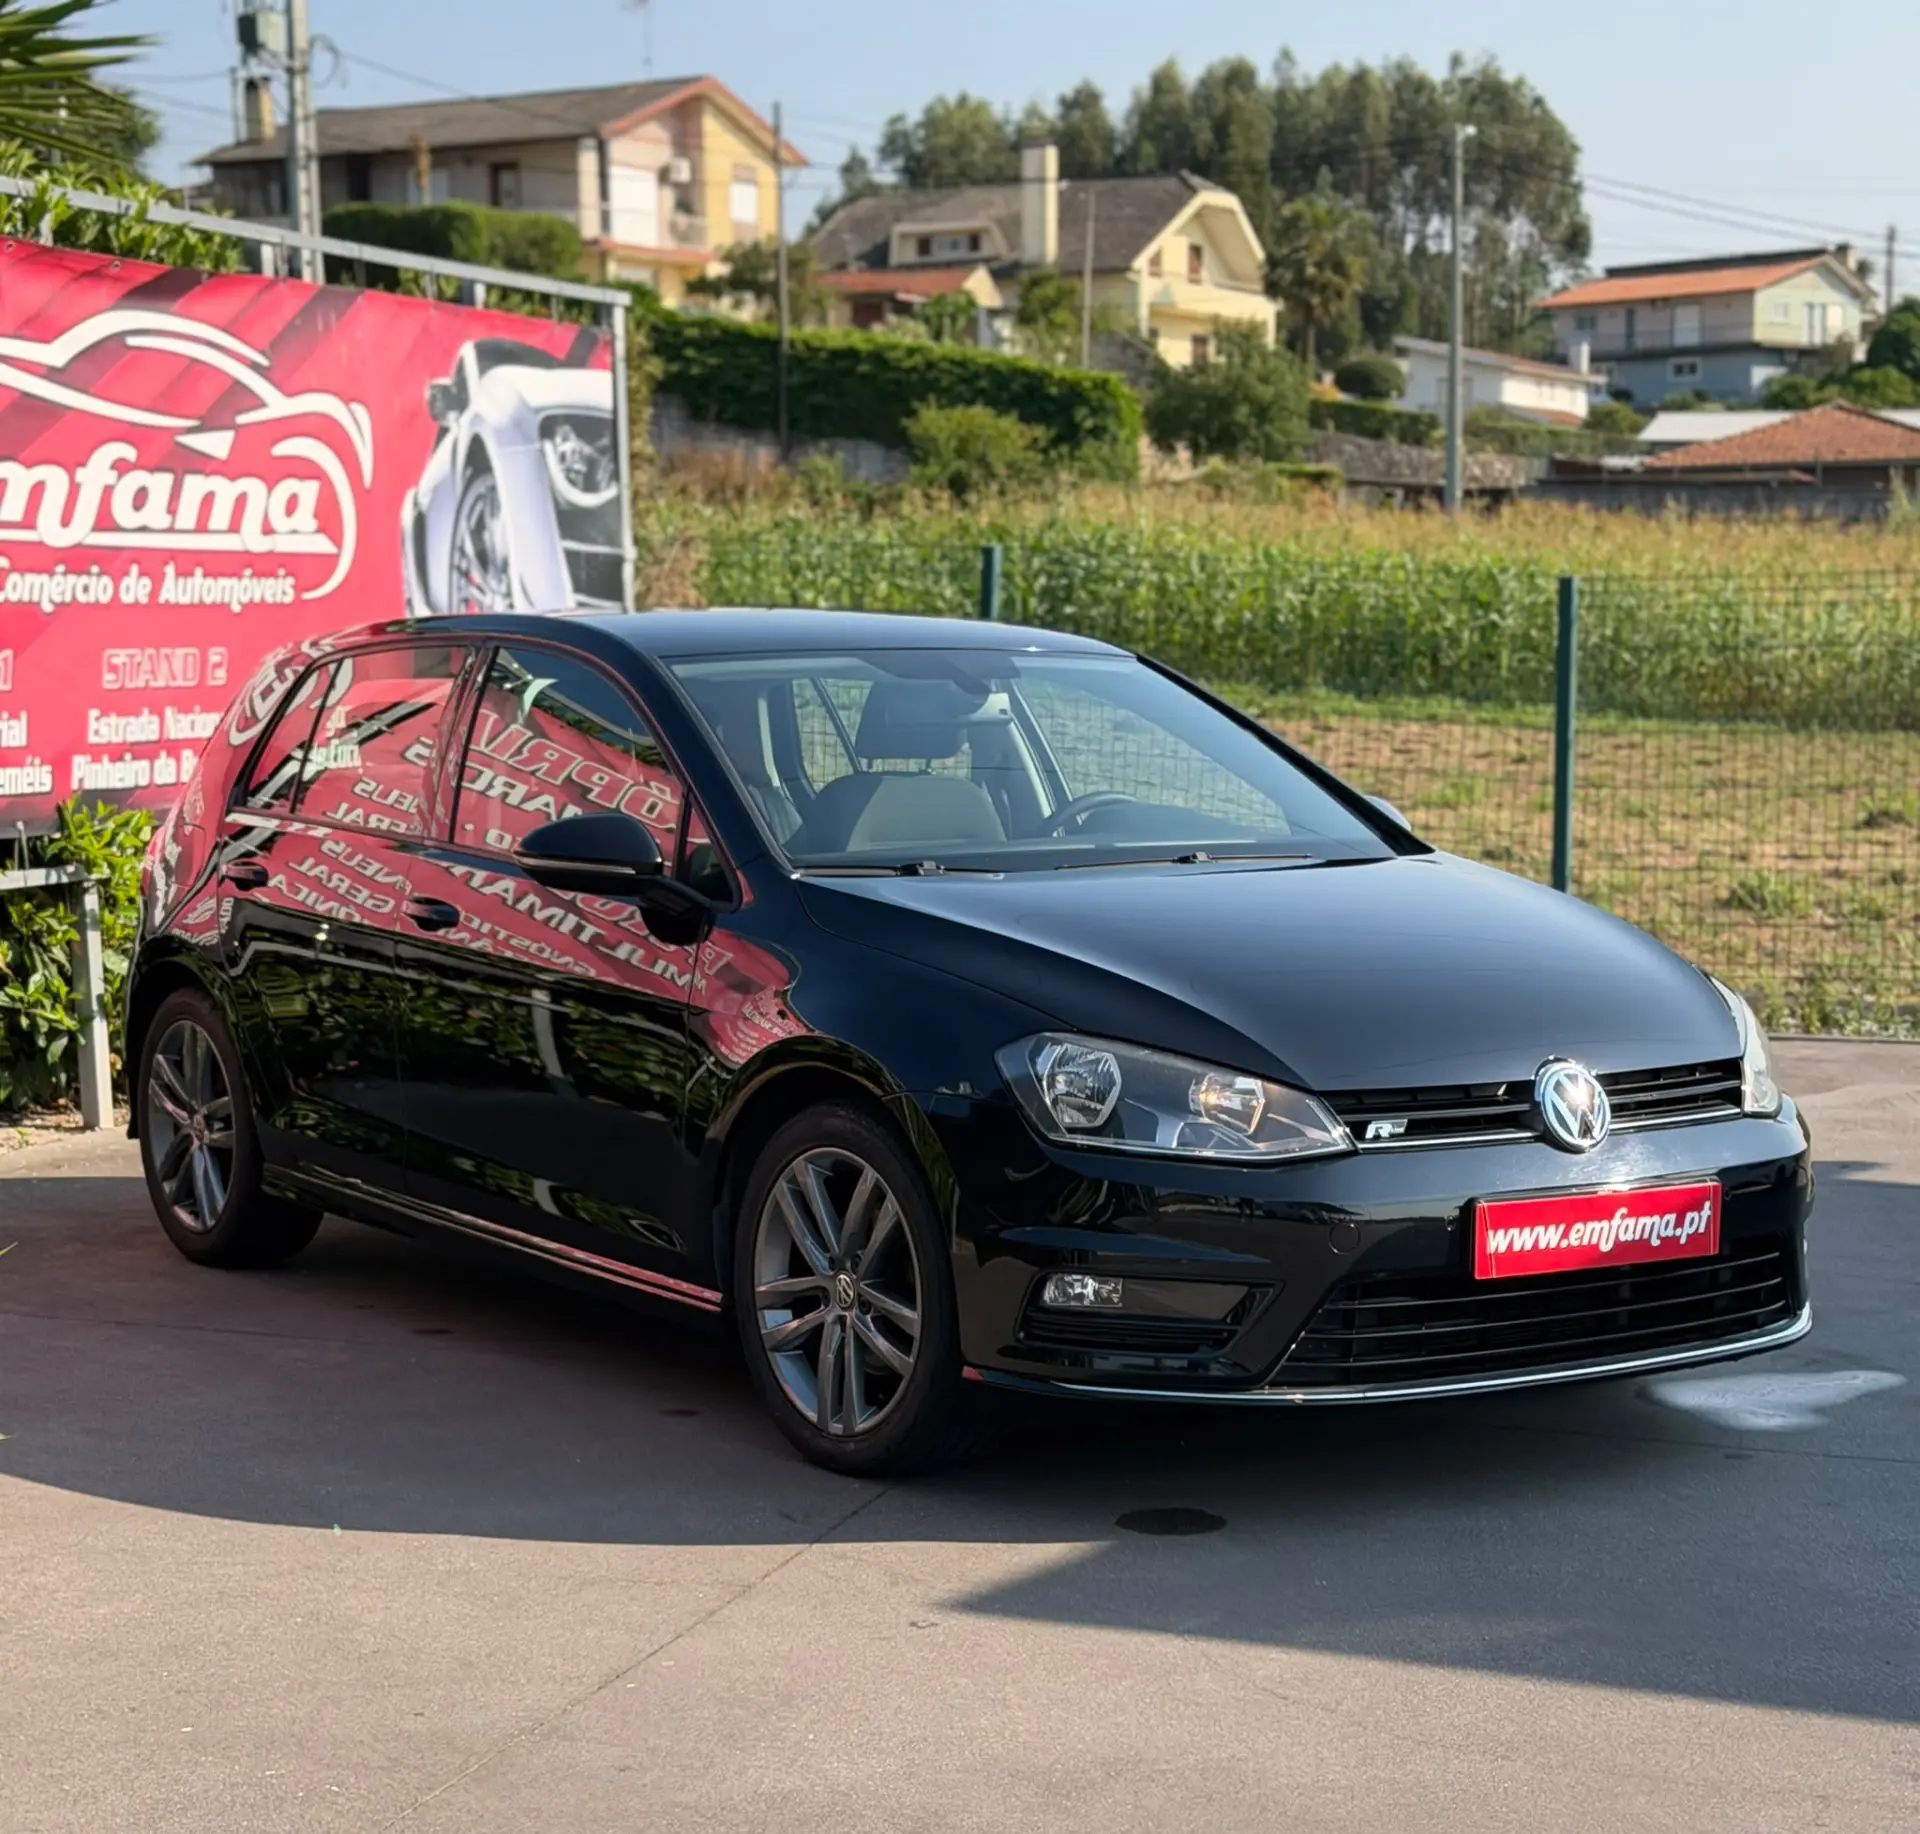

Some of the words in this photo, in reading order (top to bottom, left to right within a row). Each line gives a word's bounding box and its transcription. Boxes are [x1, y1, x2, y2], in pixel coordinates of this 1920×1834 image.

[119, 563, 152, 604] de
[157, 562, 296, 613] Automóveis
[102, 647, 201, 690] STAND
[207, 647, 229, 687] 2
[0, 711, 28, 748] ial
[87, 708, 160, 745] Estrada
[71, 751, 150, 790] Pinheiro
[153, 749, 177, 785] da
[1486, 1201, 1711, 1254] www.emfama.pt
